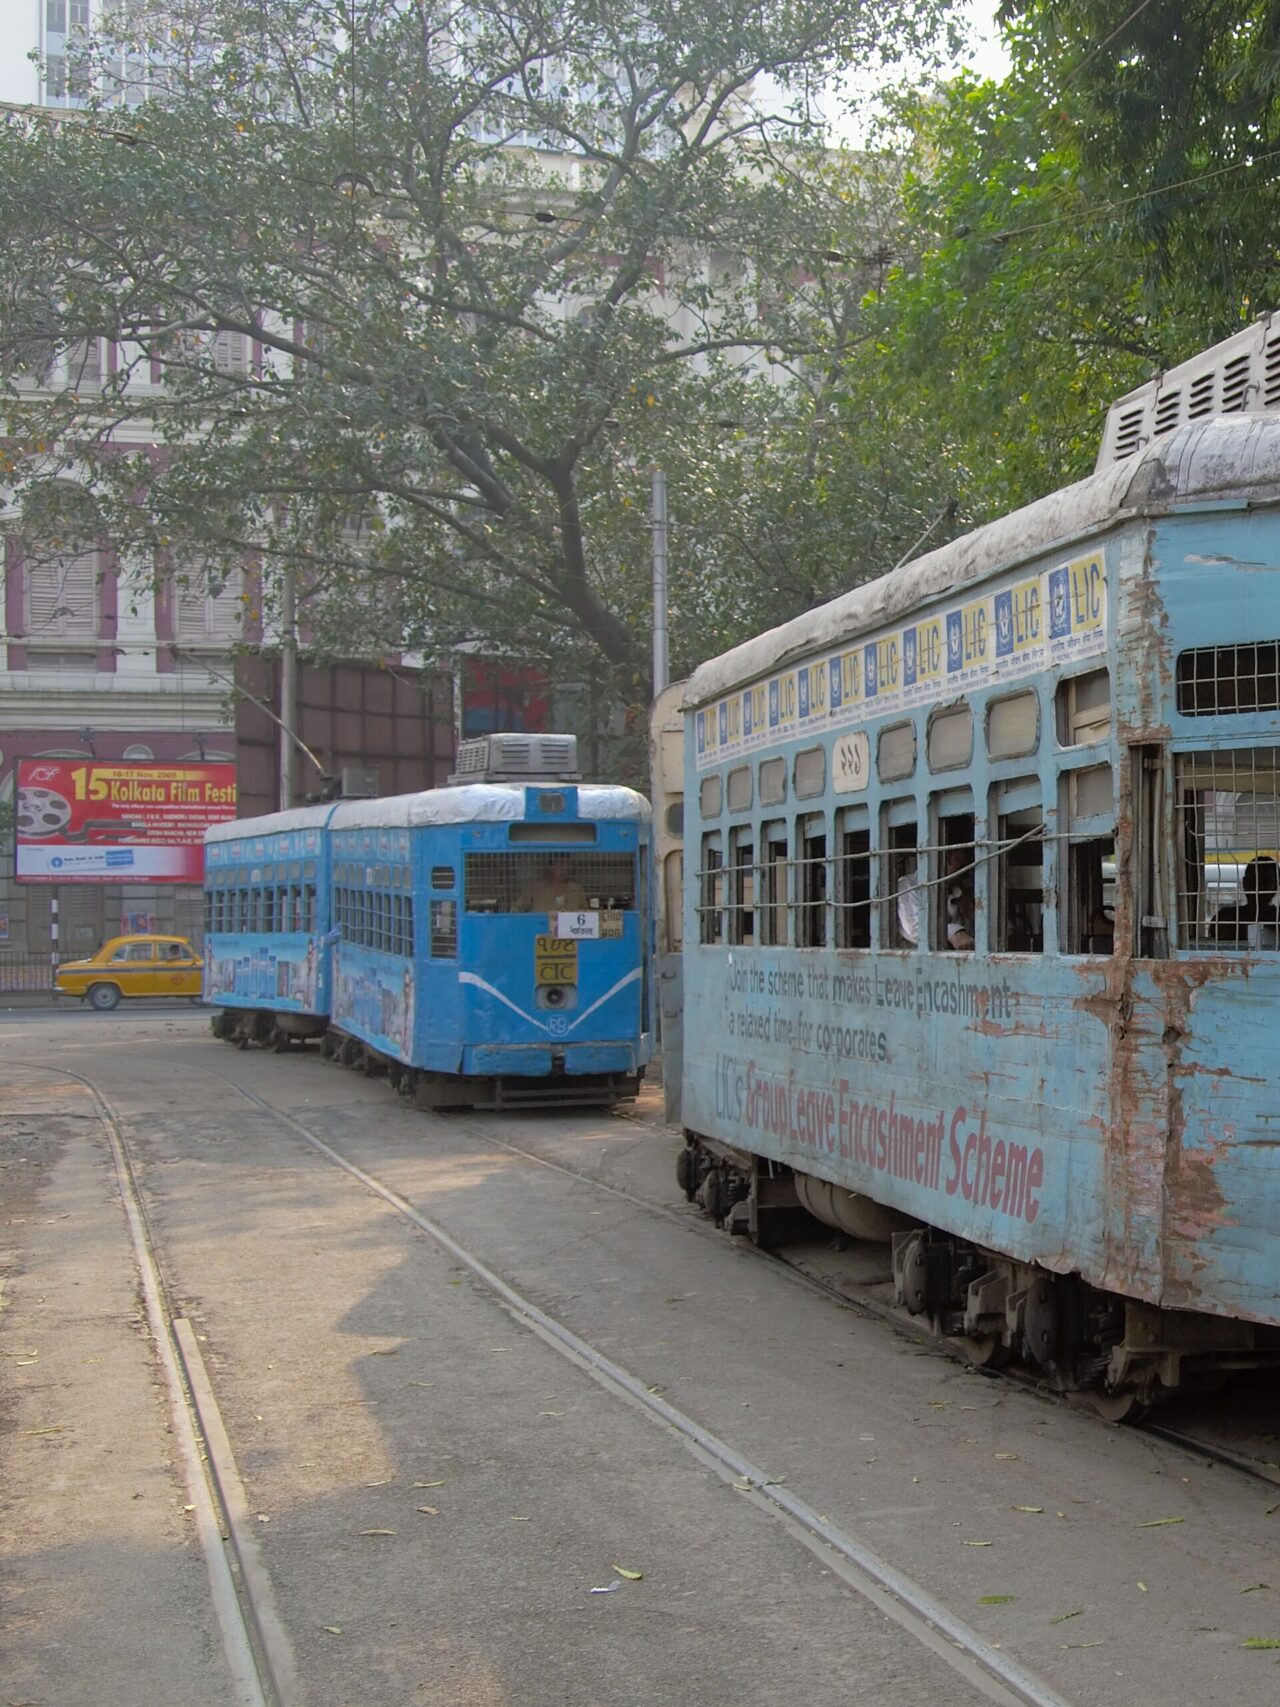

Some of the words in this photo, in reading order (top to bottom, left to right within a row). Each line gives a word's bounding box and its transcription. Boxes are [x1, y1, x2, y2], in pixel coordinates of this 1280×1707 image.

[1015, 586, 1039, 644] LIC
[1073, 562, 1100, 625] LIC
[919, 624, 940, 675] LIC
[965, 607, 986, 661] LIC
[843, 654, 860, 699] LIC
[879, 640, 897, 688] LIC
[753, 689, 765, 728] LIC
[780, 678, 794, 719] LIC
[810, 667, 825, 709] LIC
[71, 767, 108, 801] 15
[111, 781, 165, 801] Kolkata
[170, 782, 199, 802] Film
[205, 783, 236, 803] Festi
[577, 914, 586, 926] 6
[541, 962, 575, 980] CTC
[730, 960, 747, 992] Join
[750, 960, 765, 993] the
[768, 960, 804, 999] scheme
[807, 961, 829, 1000] that
[833, 962, 871, 1005] makes
[875, 964, 914, 1010] Leave
[916, 967, 1011, 1018] Encashment
[729, 1012, 735, 1036] a
[738, 1004, 770, 1042] relaxed
[798, 1010, 814, 1048] for
[817, 1023, 887, 1064] corporates
[746, 1060, 788, 1147] Group
[789, 1068, 835, 1153] Leave
[839, 1078, 945, 1190] Encashment
[945, 1106, 1044, 1224] Scheme
